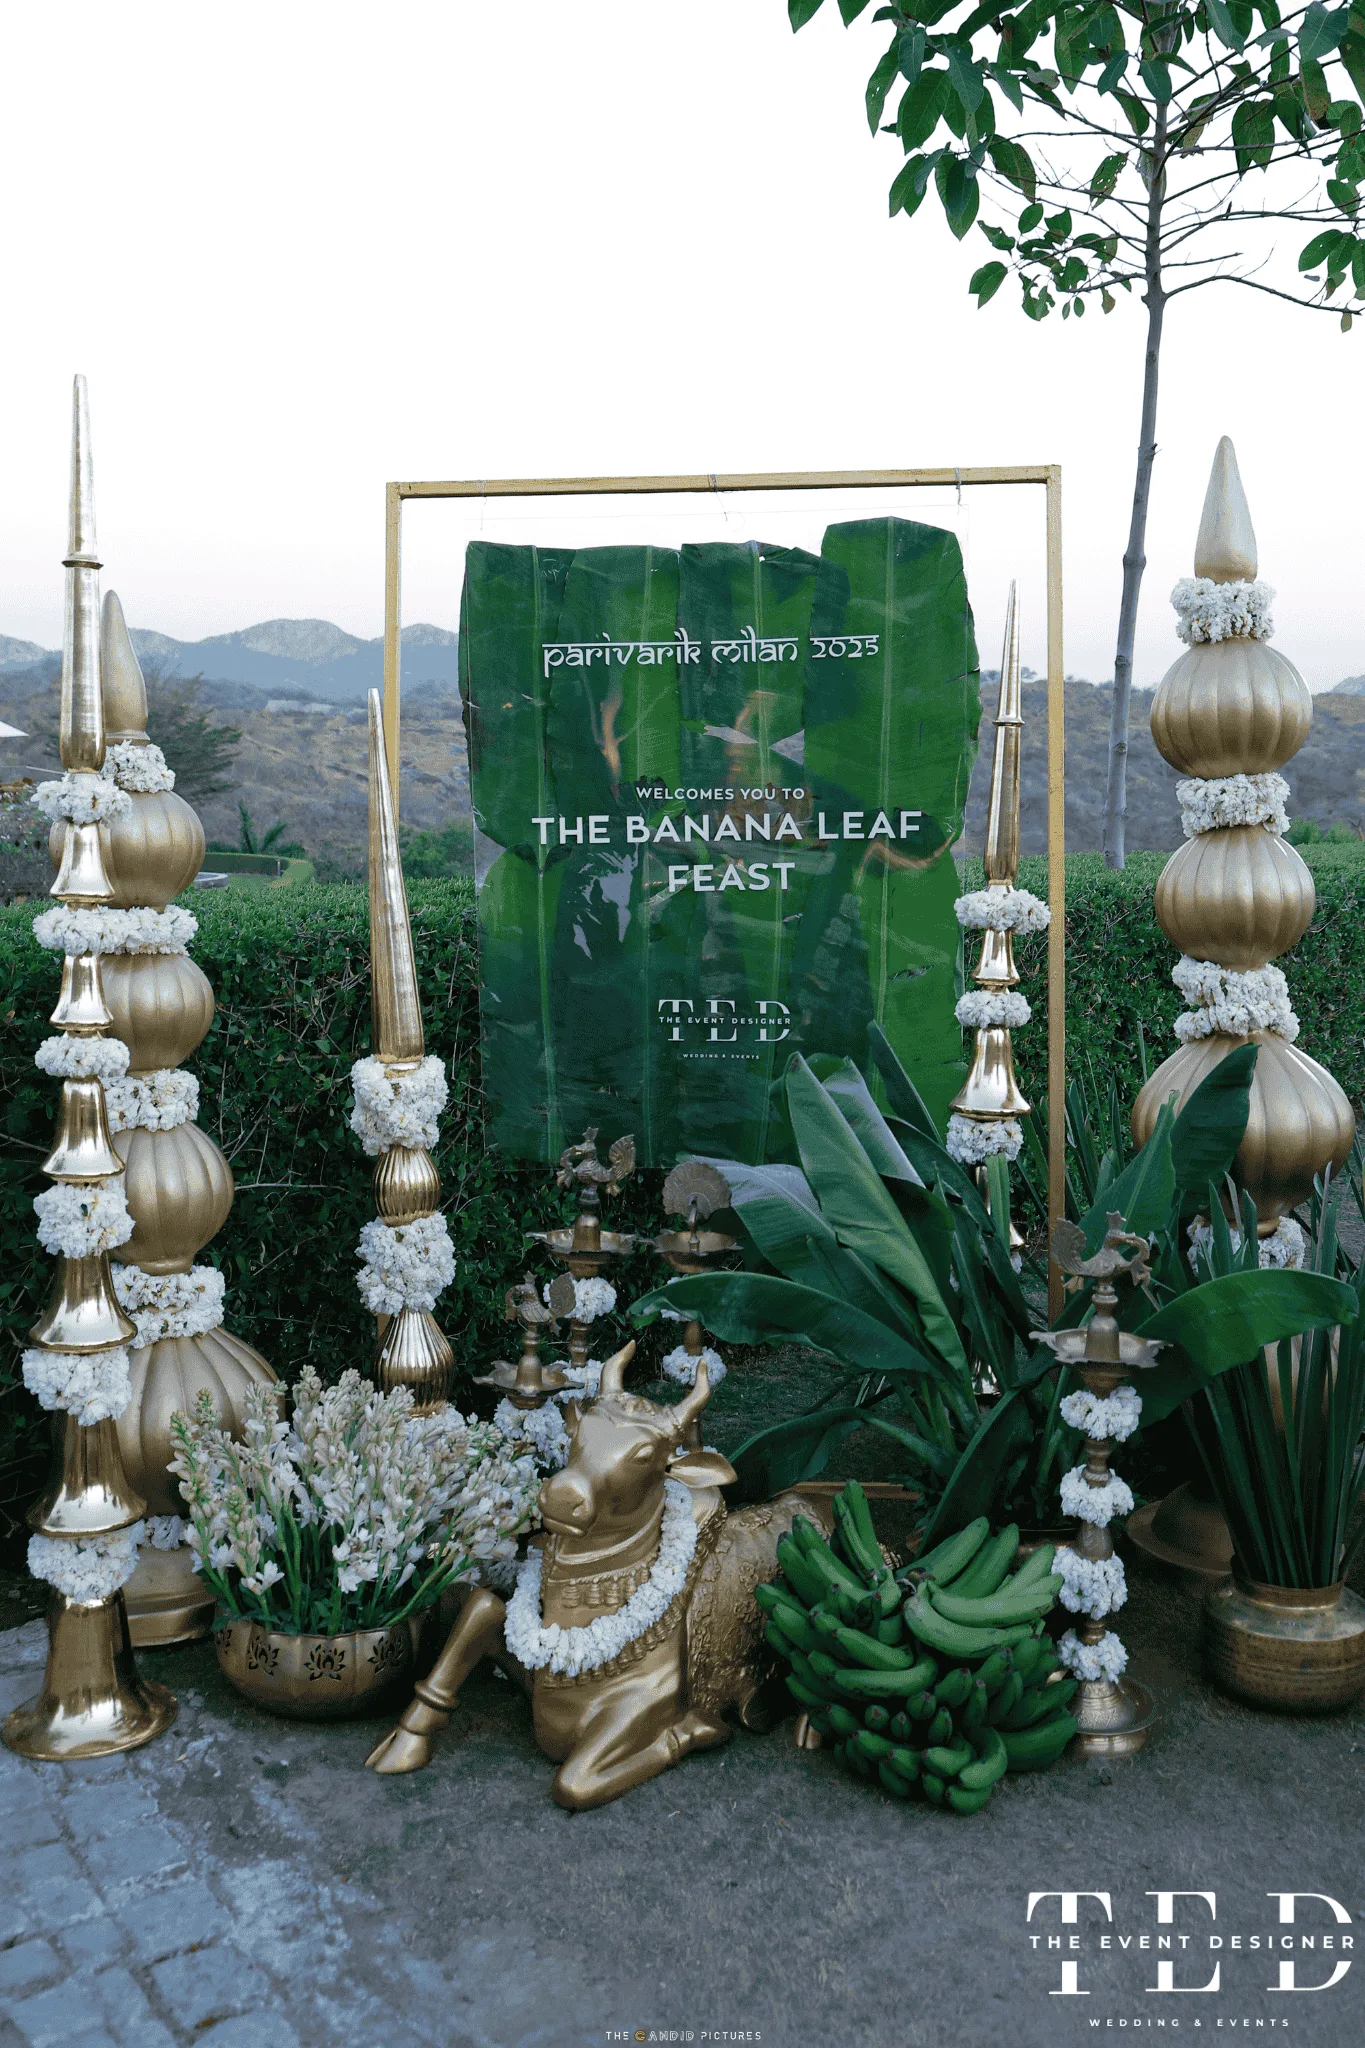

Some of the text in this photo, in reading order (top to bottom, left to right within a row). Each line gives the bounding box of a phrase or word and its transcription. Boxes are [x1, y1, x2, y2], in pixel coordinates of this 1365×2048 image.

[542, 625, 880, 678] parivarik milan 2025
[636, 786, 805, 800] WELCOMES YOU TO
[532, 811, 922, 845] THE BANANA LEAF
[668, 862, 796, 892] FEAST
[658, 1000, 790, 1041] TED
[659, 1016, 681, 1024] THE
[688, 1017, 725, 1025] EVENT
